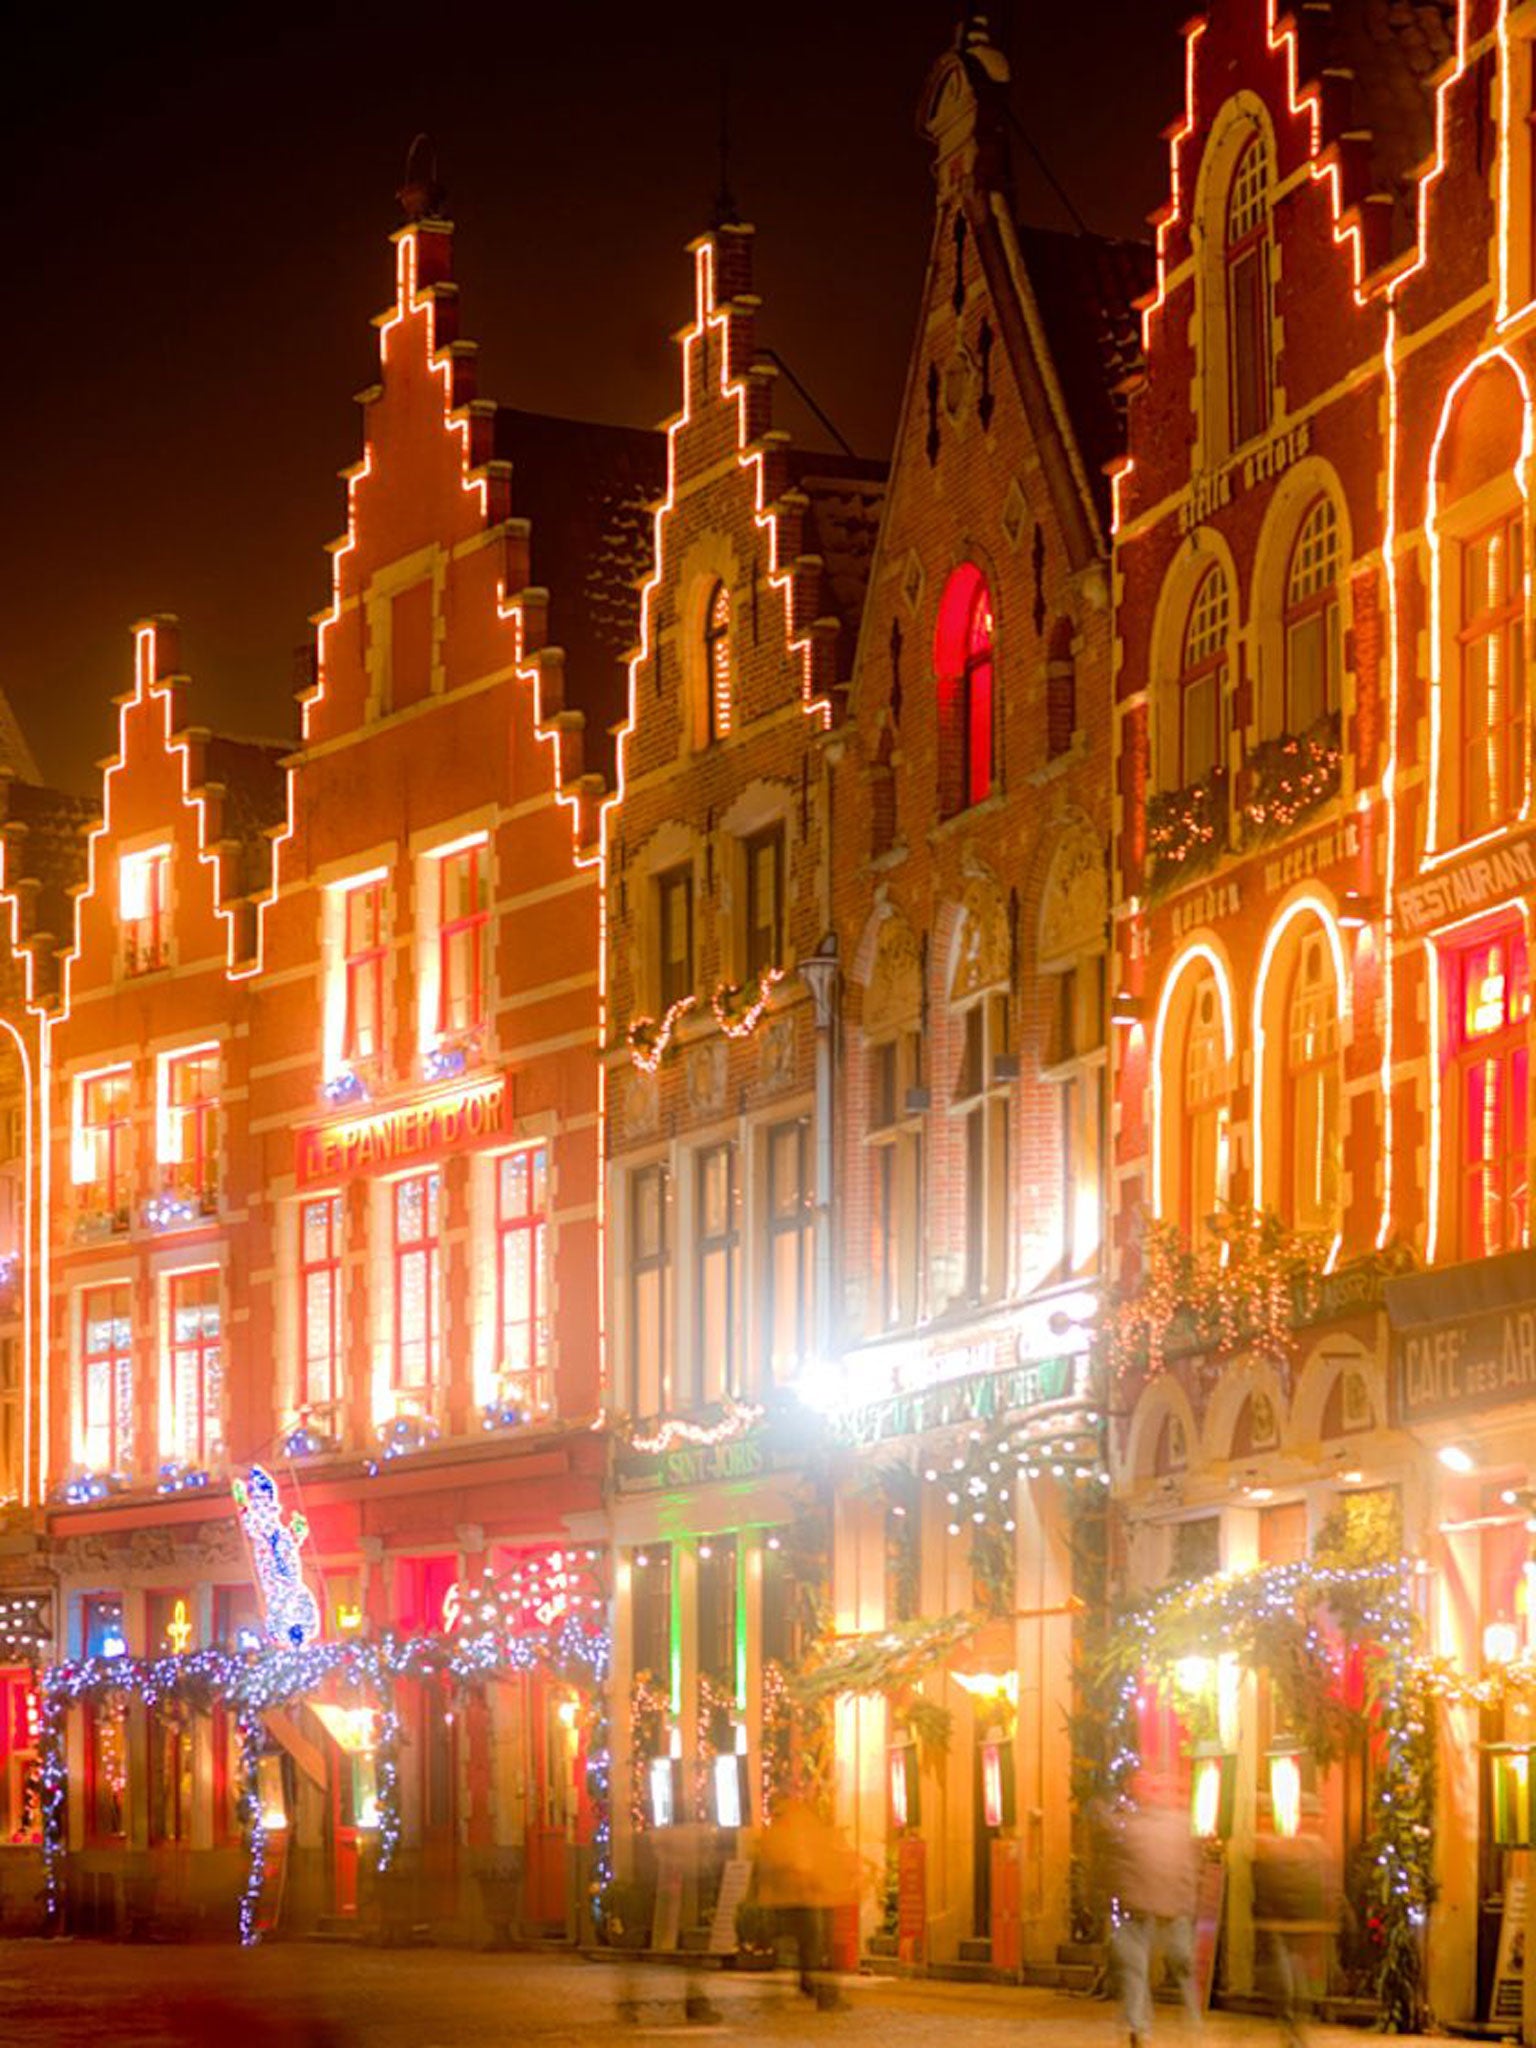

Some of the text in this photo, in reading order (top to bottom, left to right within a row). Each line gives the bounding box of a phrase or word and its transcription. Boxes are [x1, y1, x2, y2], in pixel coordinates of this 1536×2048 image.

[1397, 841, 1536, 931] RESTAURANT
[304, 1090, 505, 1179] LE PANIER D'OR
[1502, 1312, 1536, 1387] AR
